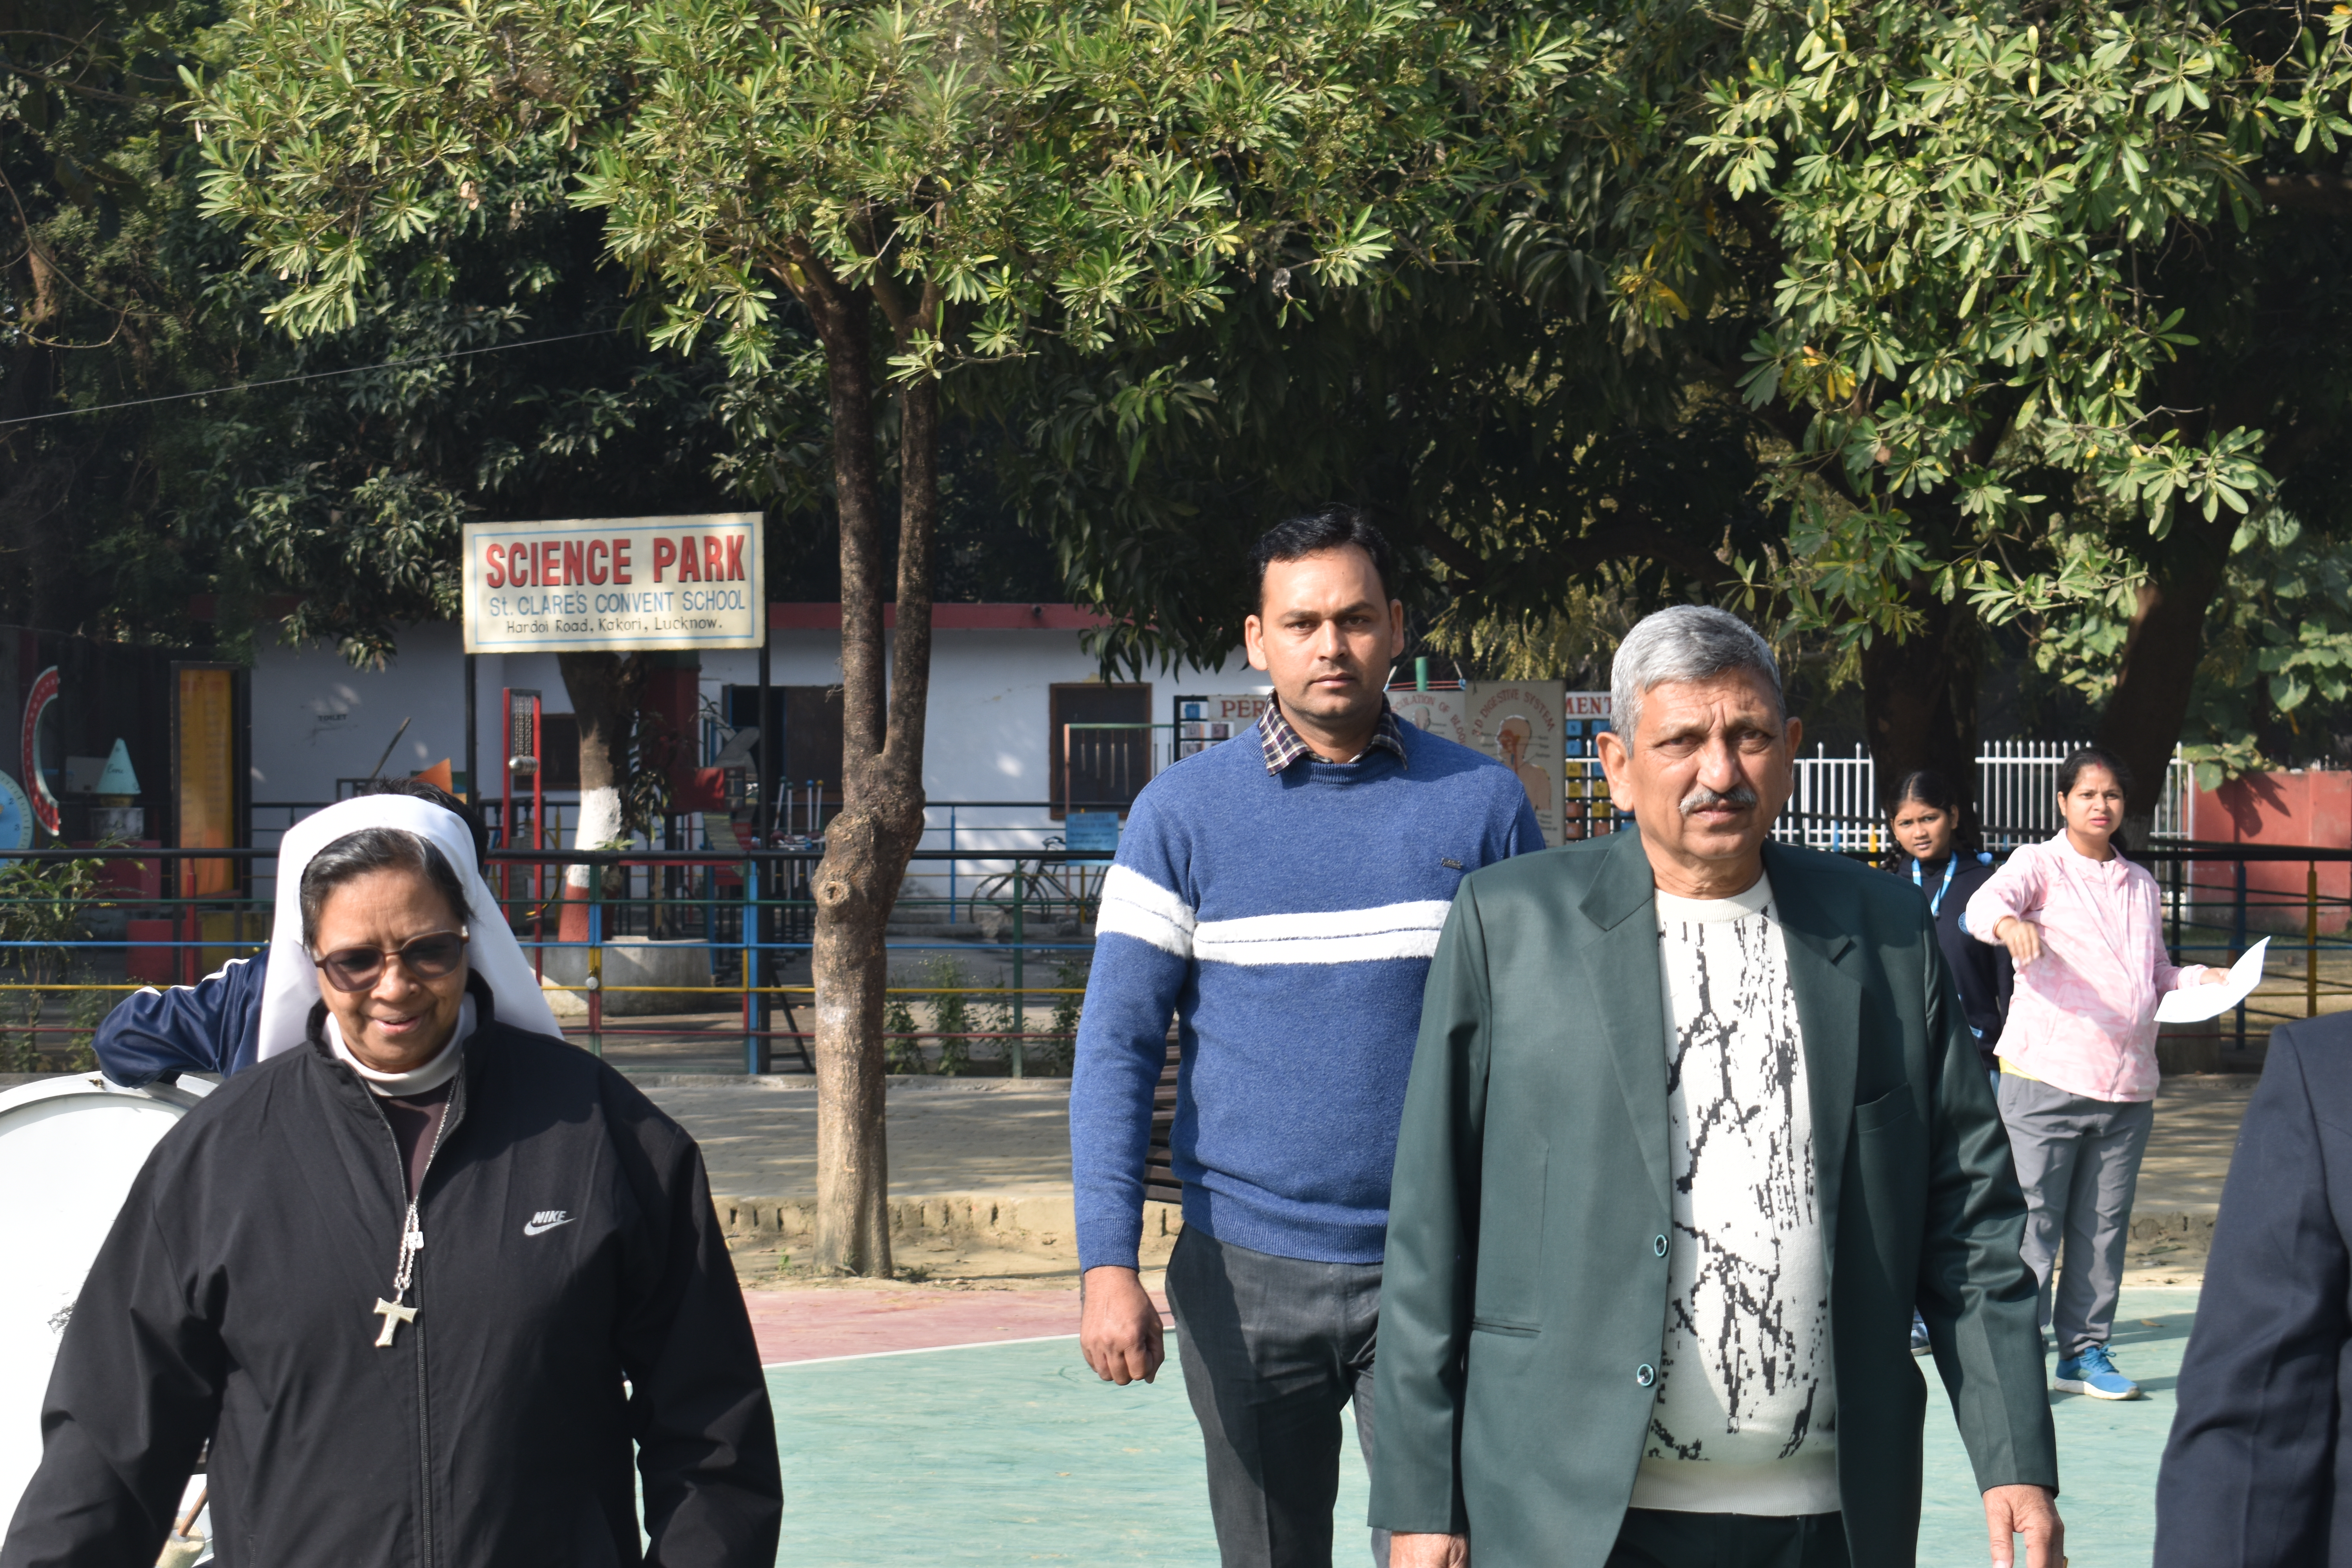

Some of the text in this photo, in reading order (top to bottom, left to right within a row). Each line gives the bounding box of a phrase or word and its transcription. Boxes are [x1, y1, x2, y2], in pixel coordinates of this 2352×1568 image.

[486, 534, 745, 589] SCIENCE PARK
[490, 590, 745, 617] St. CLARE'S CONVENT SCHOOL
[507, 617, 723, 633] Hardoi Road, Kakori, Lucknow.
[1479, 688, 1519, 718] DIGESTIVE
[1524, 691, 1555, 732] SYSTEM
[532, 1210, 567, 1223] NIKE
